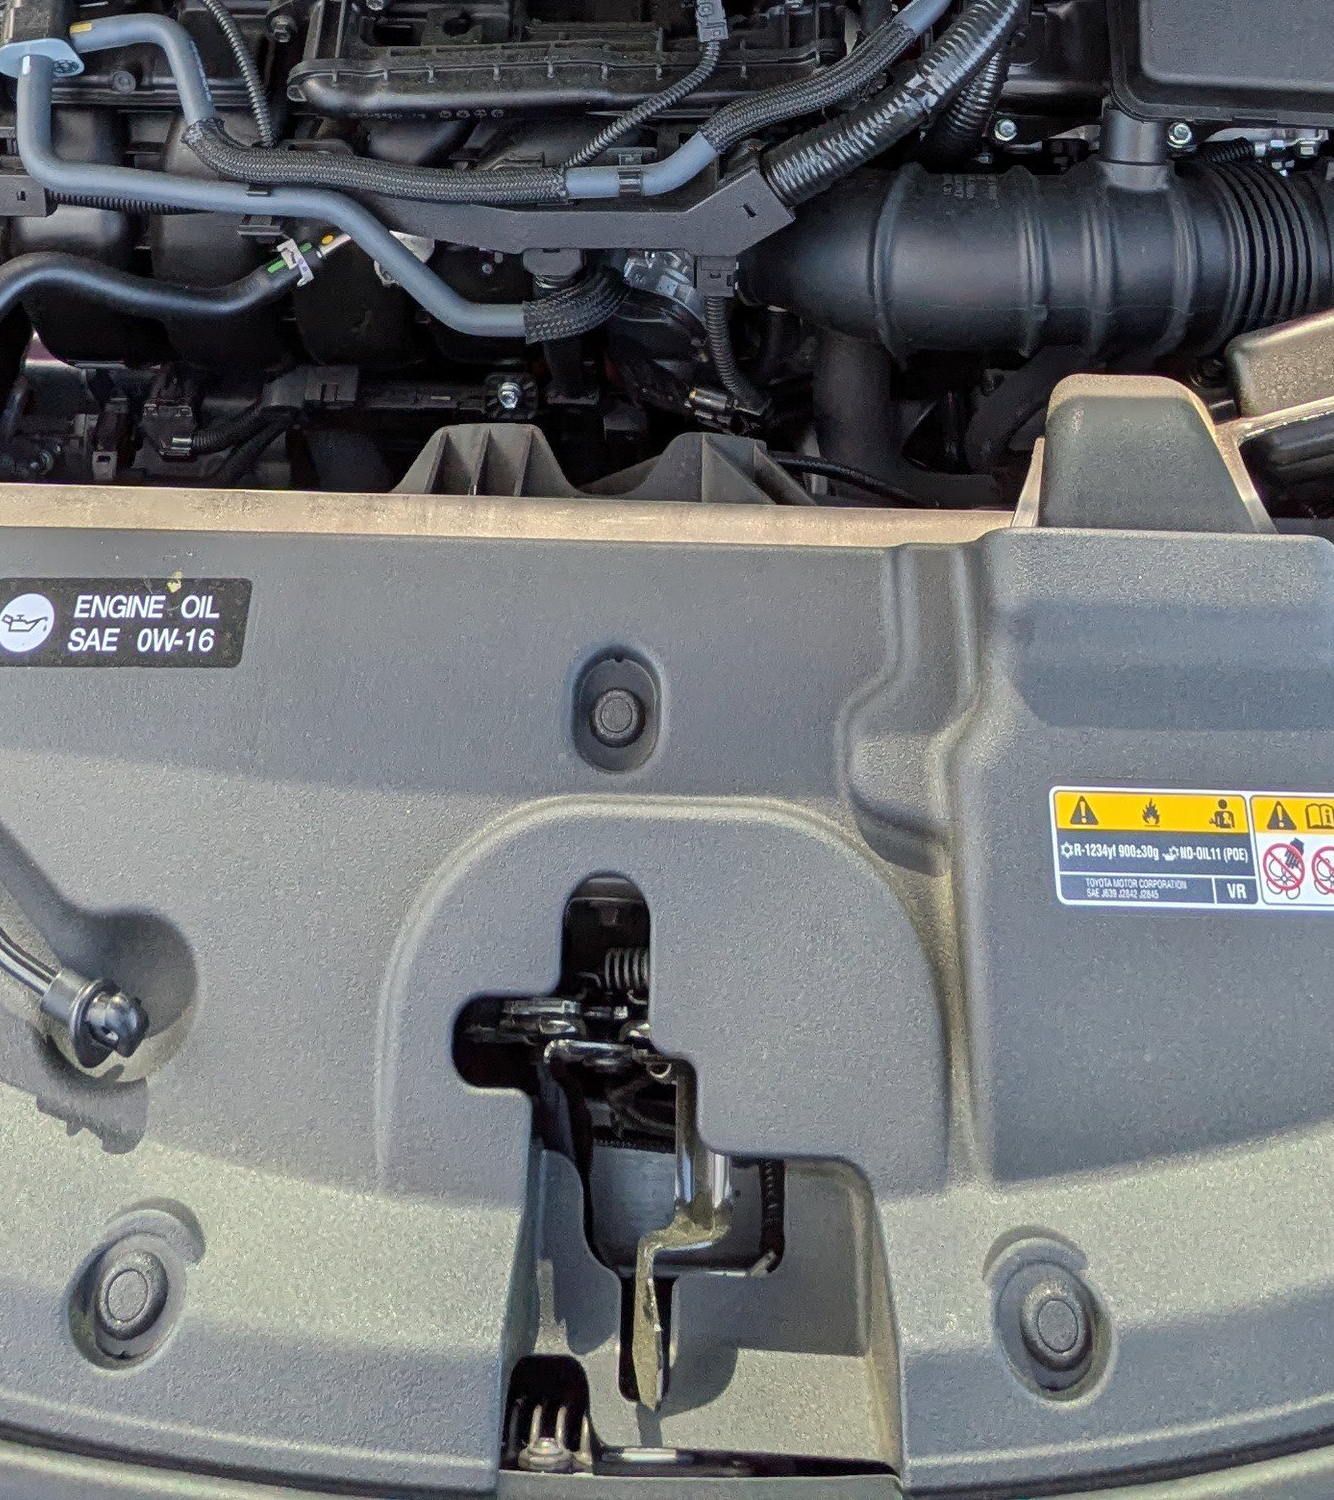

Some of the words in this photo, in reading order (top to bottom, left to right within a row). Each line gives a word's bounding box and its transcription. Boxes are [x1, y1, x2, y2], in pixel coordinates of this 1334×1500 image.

[74, 594, 167, 619] ENGINE
[180, 594, 221, 619] OIL
[67, 628, 119, 651] SAE
[136, 628, 216, 652] 0W-16
[1074, 843, 1117, 859] R-1234yf
[1118, 845, 1160, 861] 900±30g
[1180, 846, 1222, 861] ND-OIL11
[1223, 847, 1249, 863] (POE)
[1086, 877, 1113, 888] TOYOTA
[1113, 878, 1138, 889] MOTOR
[1139, 879, 1188, 890] CORPORATION
[1226, 883, 1248, 899] VR
[1086, 888, 1101, 898] SAE
